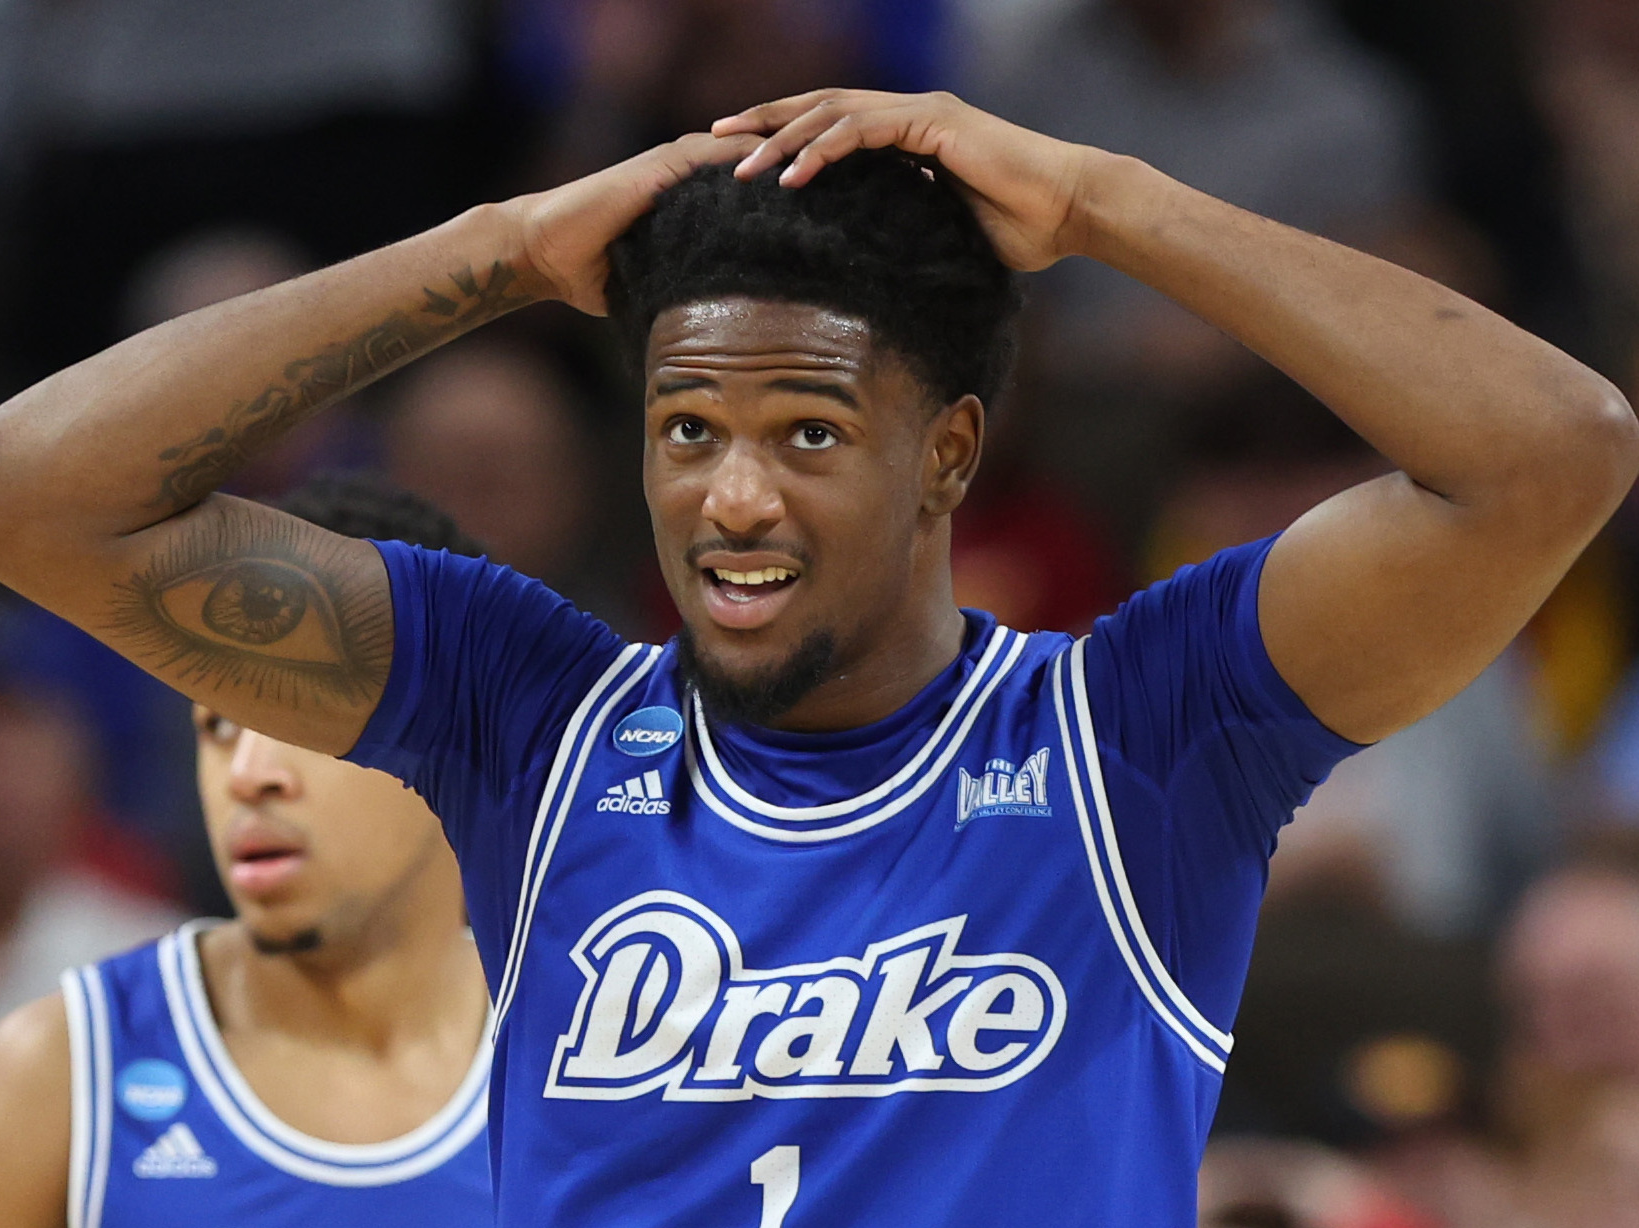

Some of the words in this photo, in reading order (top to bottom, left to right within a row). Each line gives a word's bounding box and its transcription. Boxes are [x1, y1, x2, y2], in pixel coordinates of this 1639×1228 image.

[619, 728, 677, 744] NCAA
[596, 795, 672, 815] adidas
[956, 747, 1050, 823] VALLEY
[544, 890, 1068, 1100] Drake
